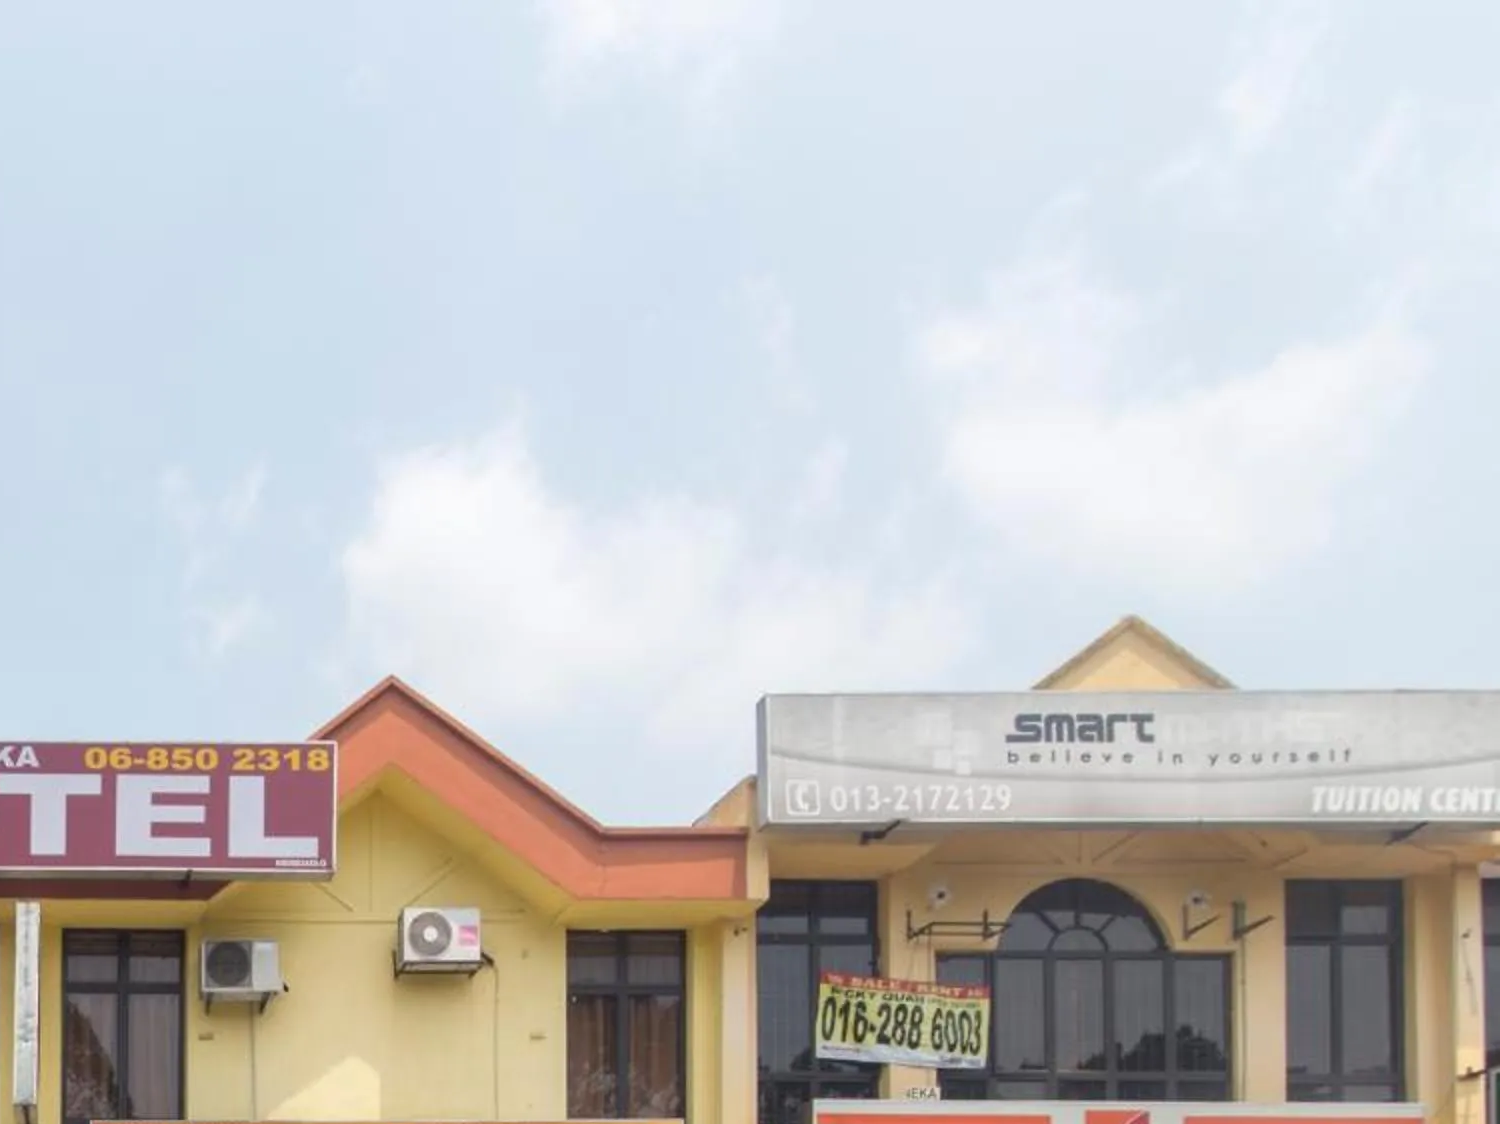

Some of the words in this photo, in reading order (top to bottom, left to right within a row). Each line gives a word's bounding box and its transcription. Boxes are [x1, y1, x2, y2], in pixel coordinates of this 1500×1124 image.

[1005, 713, 1156, 743] smart
[84, 747, 218, 771] 06-850
[232, 748, 330, 772] 2318
[1006, 750, 1135, 764] believe
[1156, 751, 1183, 764] in
[1207, 748, 1353, 766] yourself
[829, 785, 1013, 812] 013-2172129
[1311, 786, 1420, 813] TUITION
[821, 996, 924, 1050] 016-288
[930, 1007, 984, 1056] 6003
